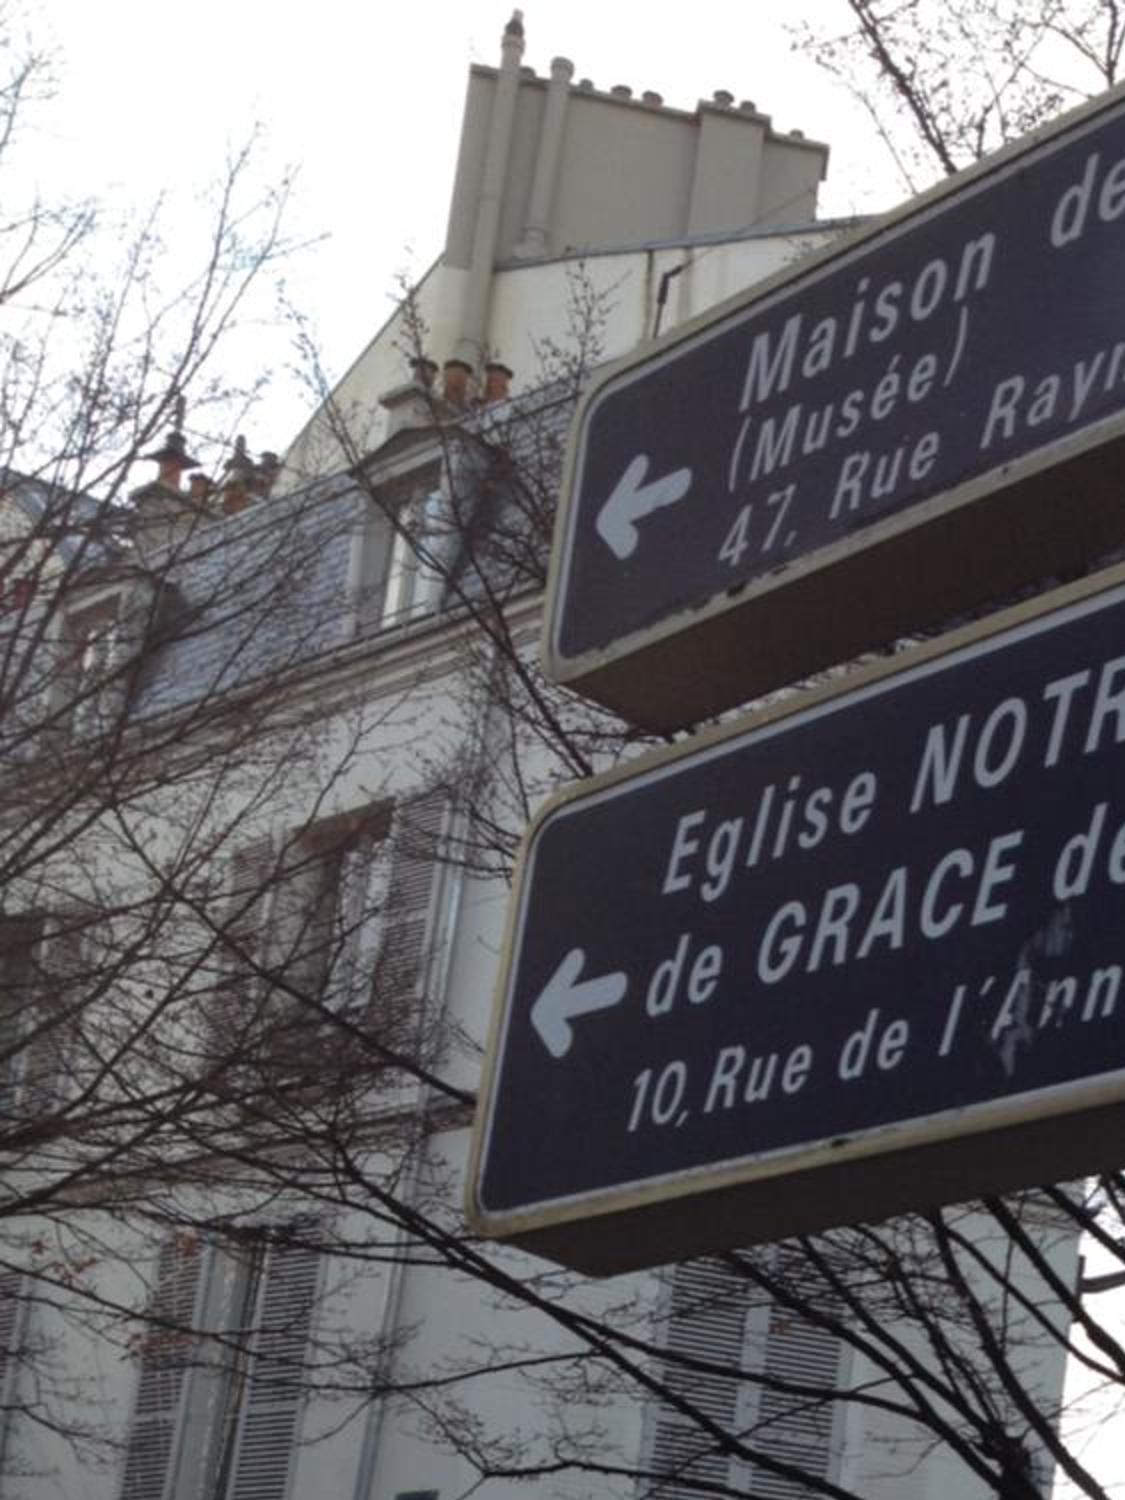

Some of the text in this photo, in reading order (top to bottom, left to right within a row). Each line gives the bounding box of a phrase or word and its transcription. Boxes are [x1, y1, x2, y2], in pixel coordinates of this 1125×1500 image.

[728, 306, 969, 493] (Musée)
[740, 232, 997, 412] Maison
[828, 426, 941, 520] Rue
[661, 771, 878, 903] Eglise
[644, 933, 724, 1018] de
[756, 829, 1025, 985] GRACE
[626, 1067, 692, 1133] 10,
[702, 1041, 814, 1114] Rue
[836, 1007, 911, 1083] de
